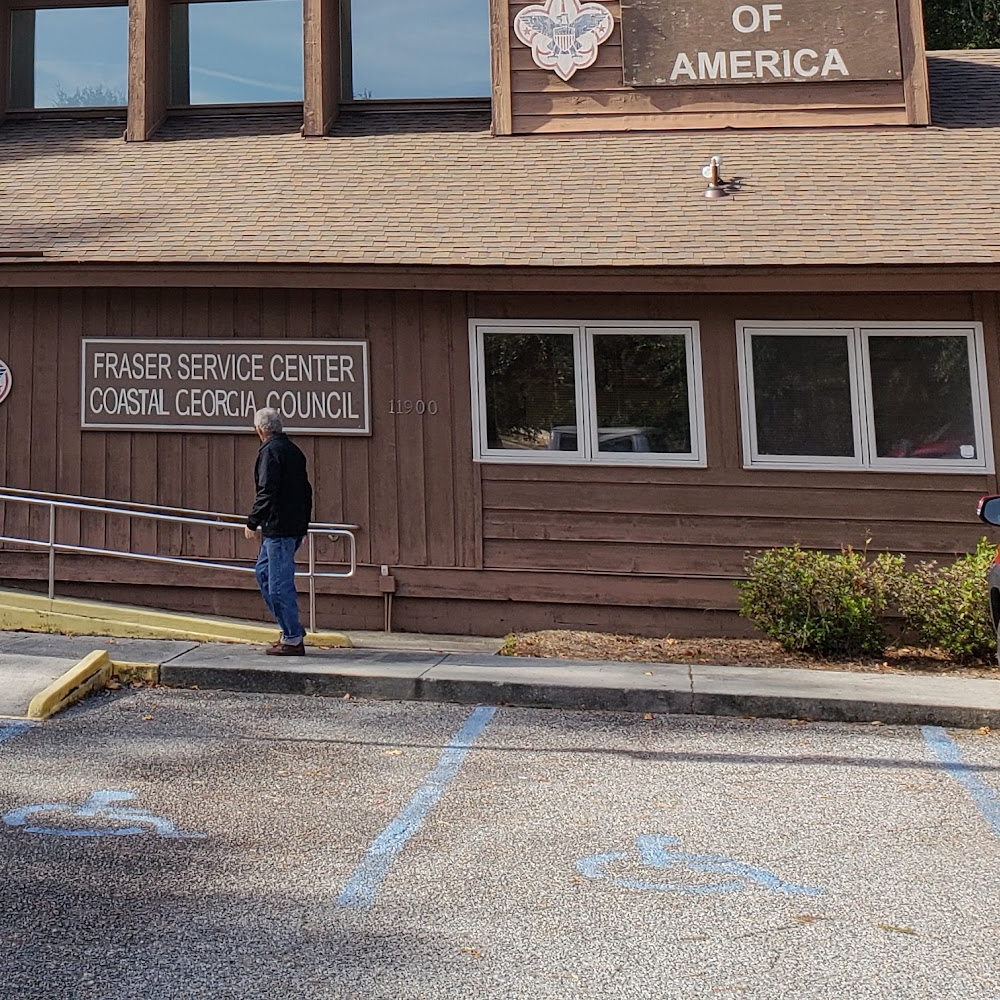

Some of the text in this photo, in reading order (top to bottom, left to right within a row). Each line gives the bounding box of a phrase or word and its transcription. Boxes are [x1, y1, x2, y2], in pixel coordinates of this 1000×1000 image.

[731, 4, 783, 34] OF
[669, 48, 850, 81] AMERICA
[93, 352, 356, 383] FRASER SERVICE CENTER
[89, 386, 360, 419] COASTAL GEORGIA COUNCIL
[388, 399, 438, 415] 11900
